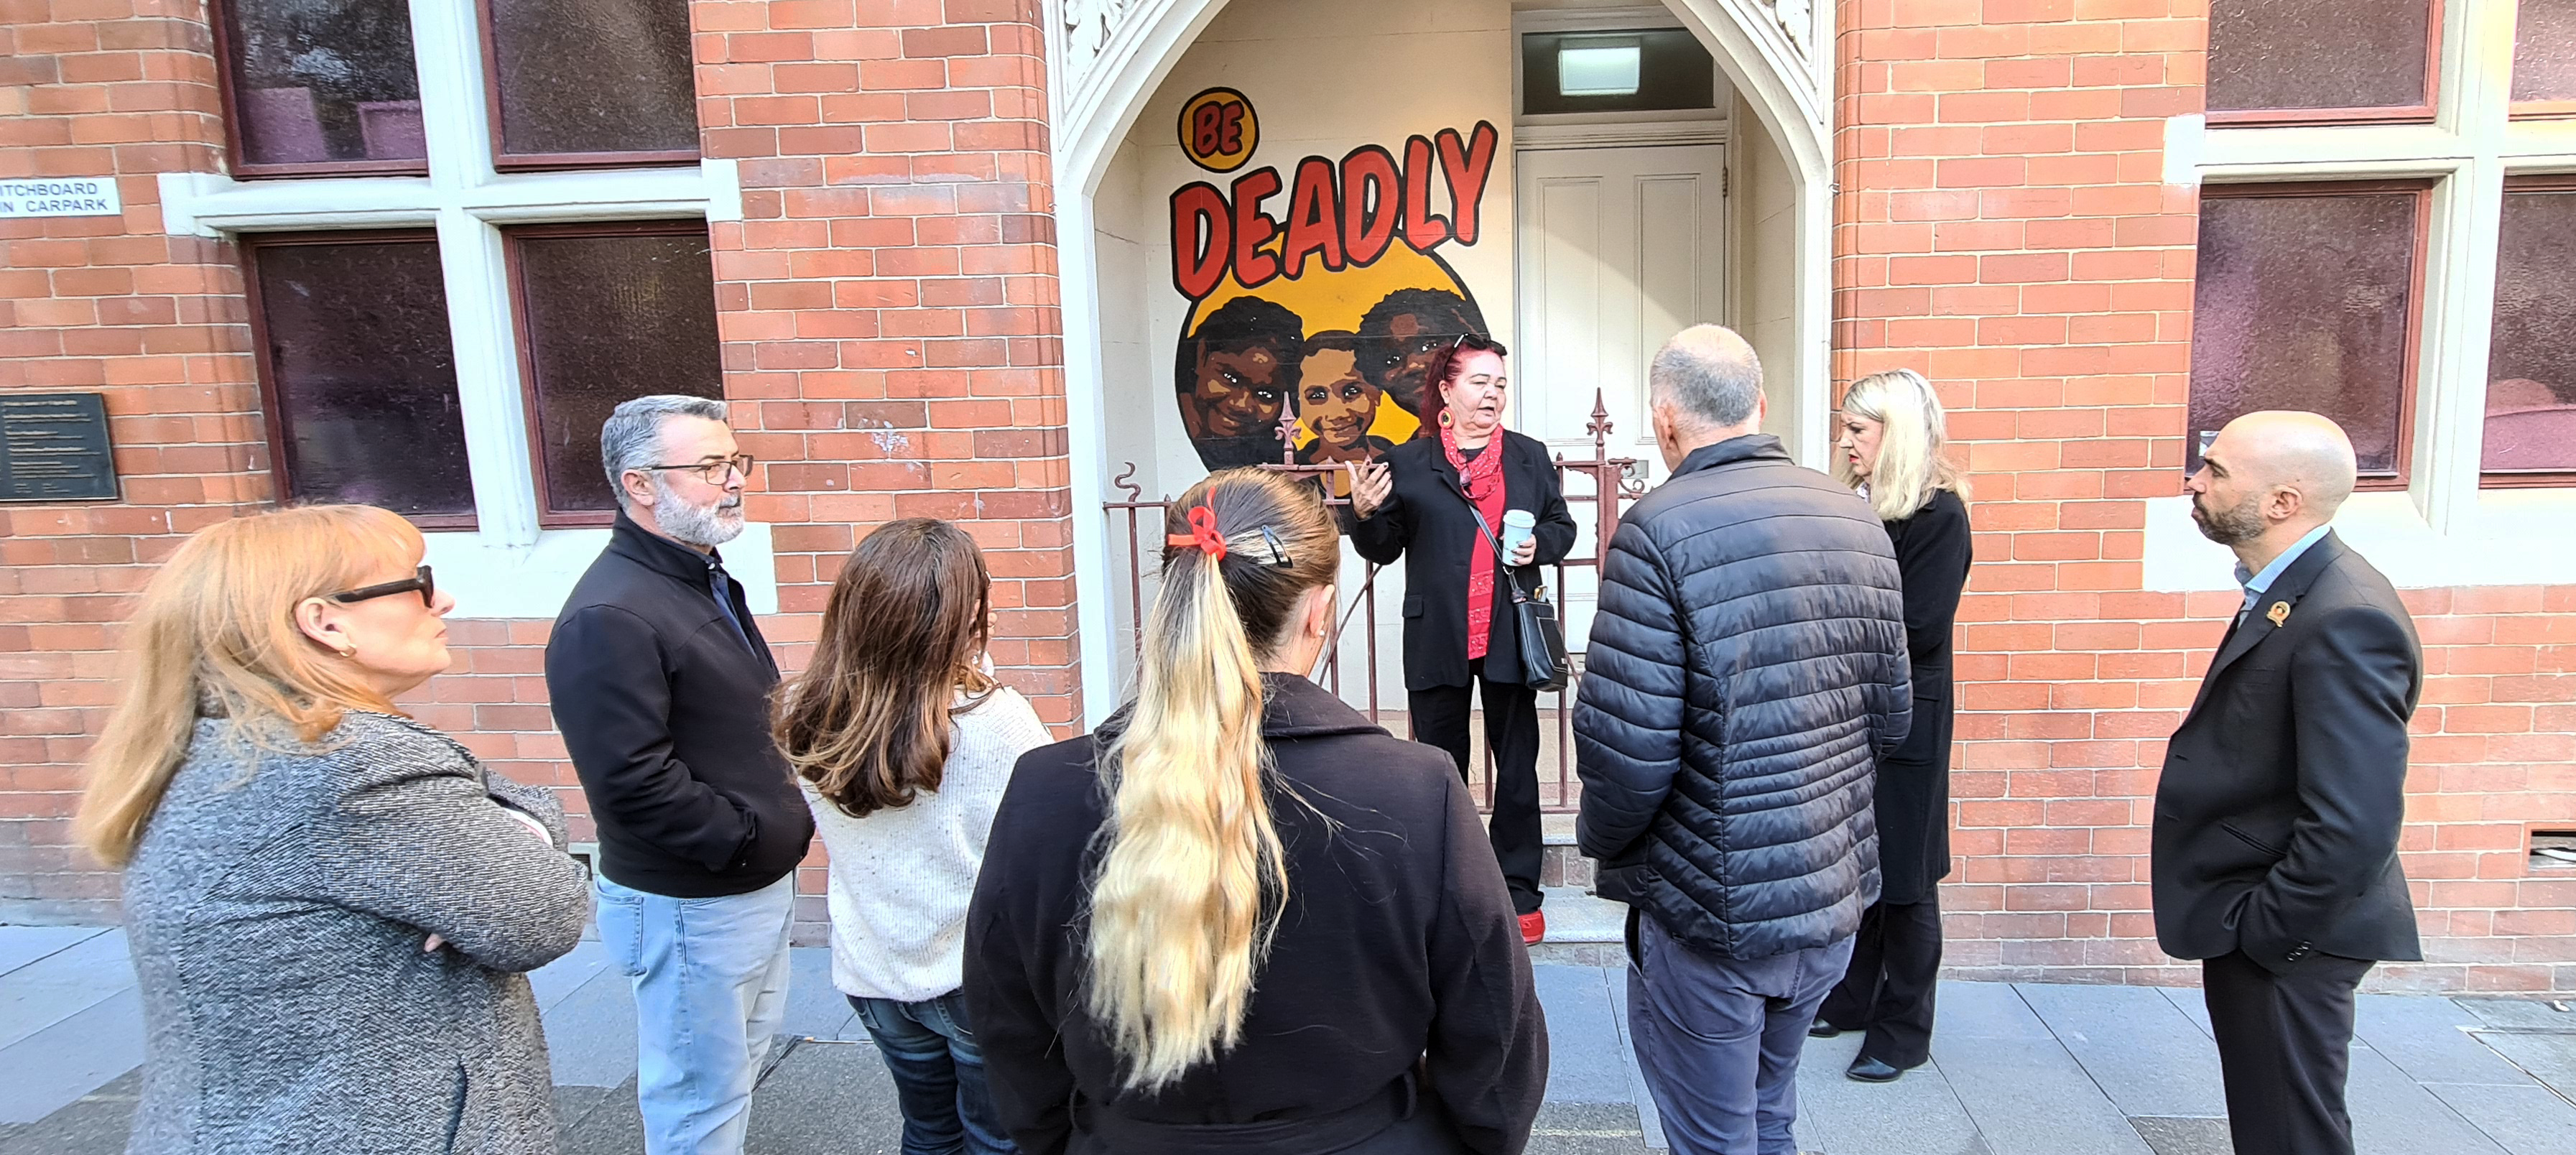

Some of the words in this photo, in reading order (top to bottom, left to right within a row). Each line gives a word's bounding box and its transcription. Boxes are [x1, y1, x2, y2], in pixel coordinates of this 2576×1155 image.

[1192, 101, 1244, 157] BE
[26, 199, 108, 212] CARPARK
[1170, 121, 1498, 300] DEADLY
